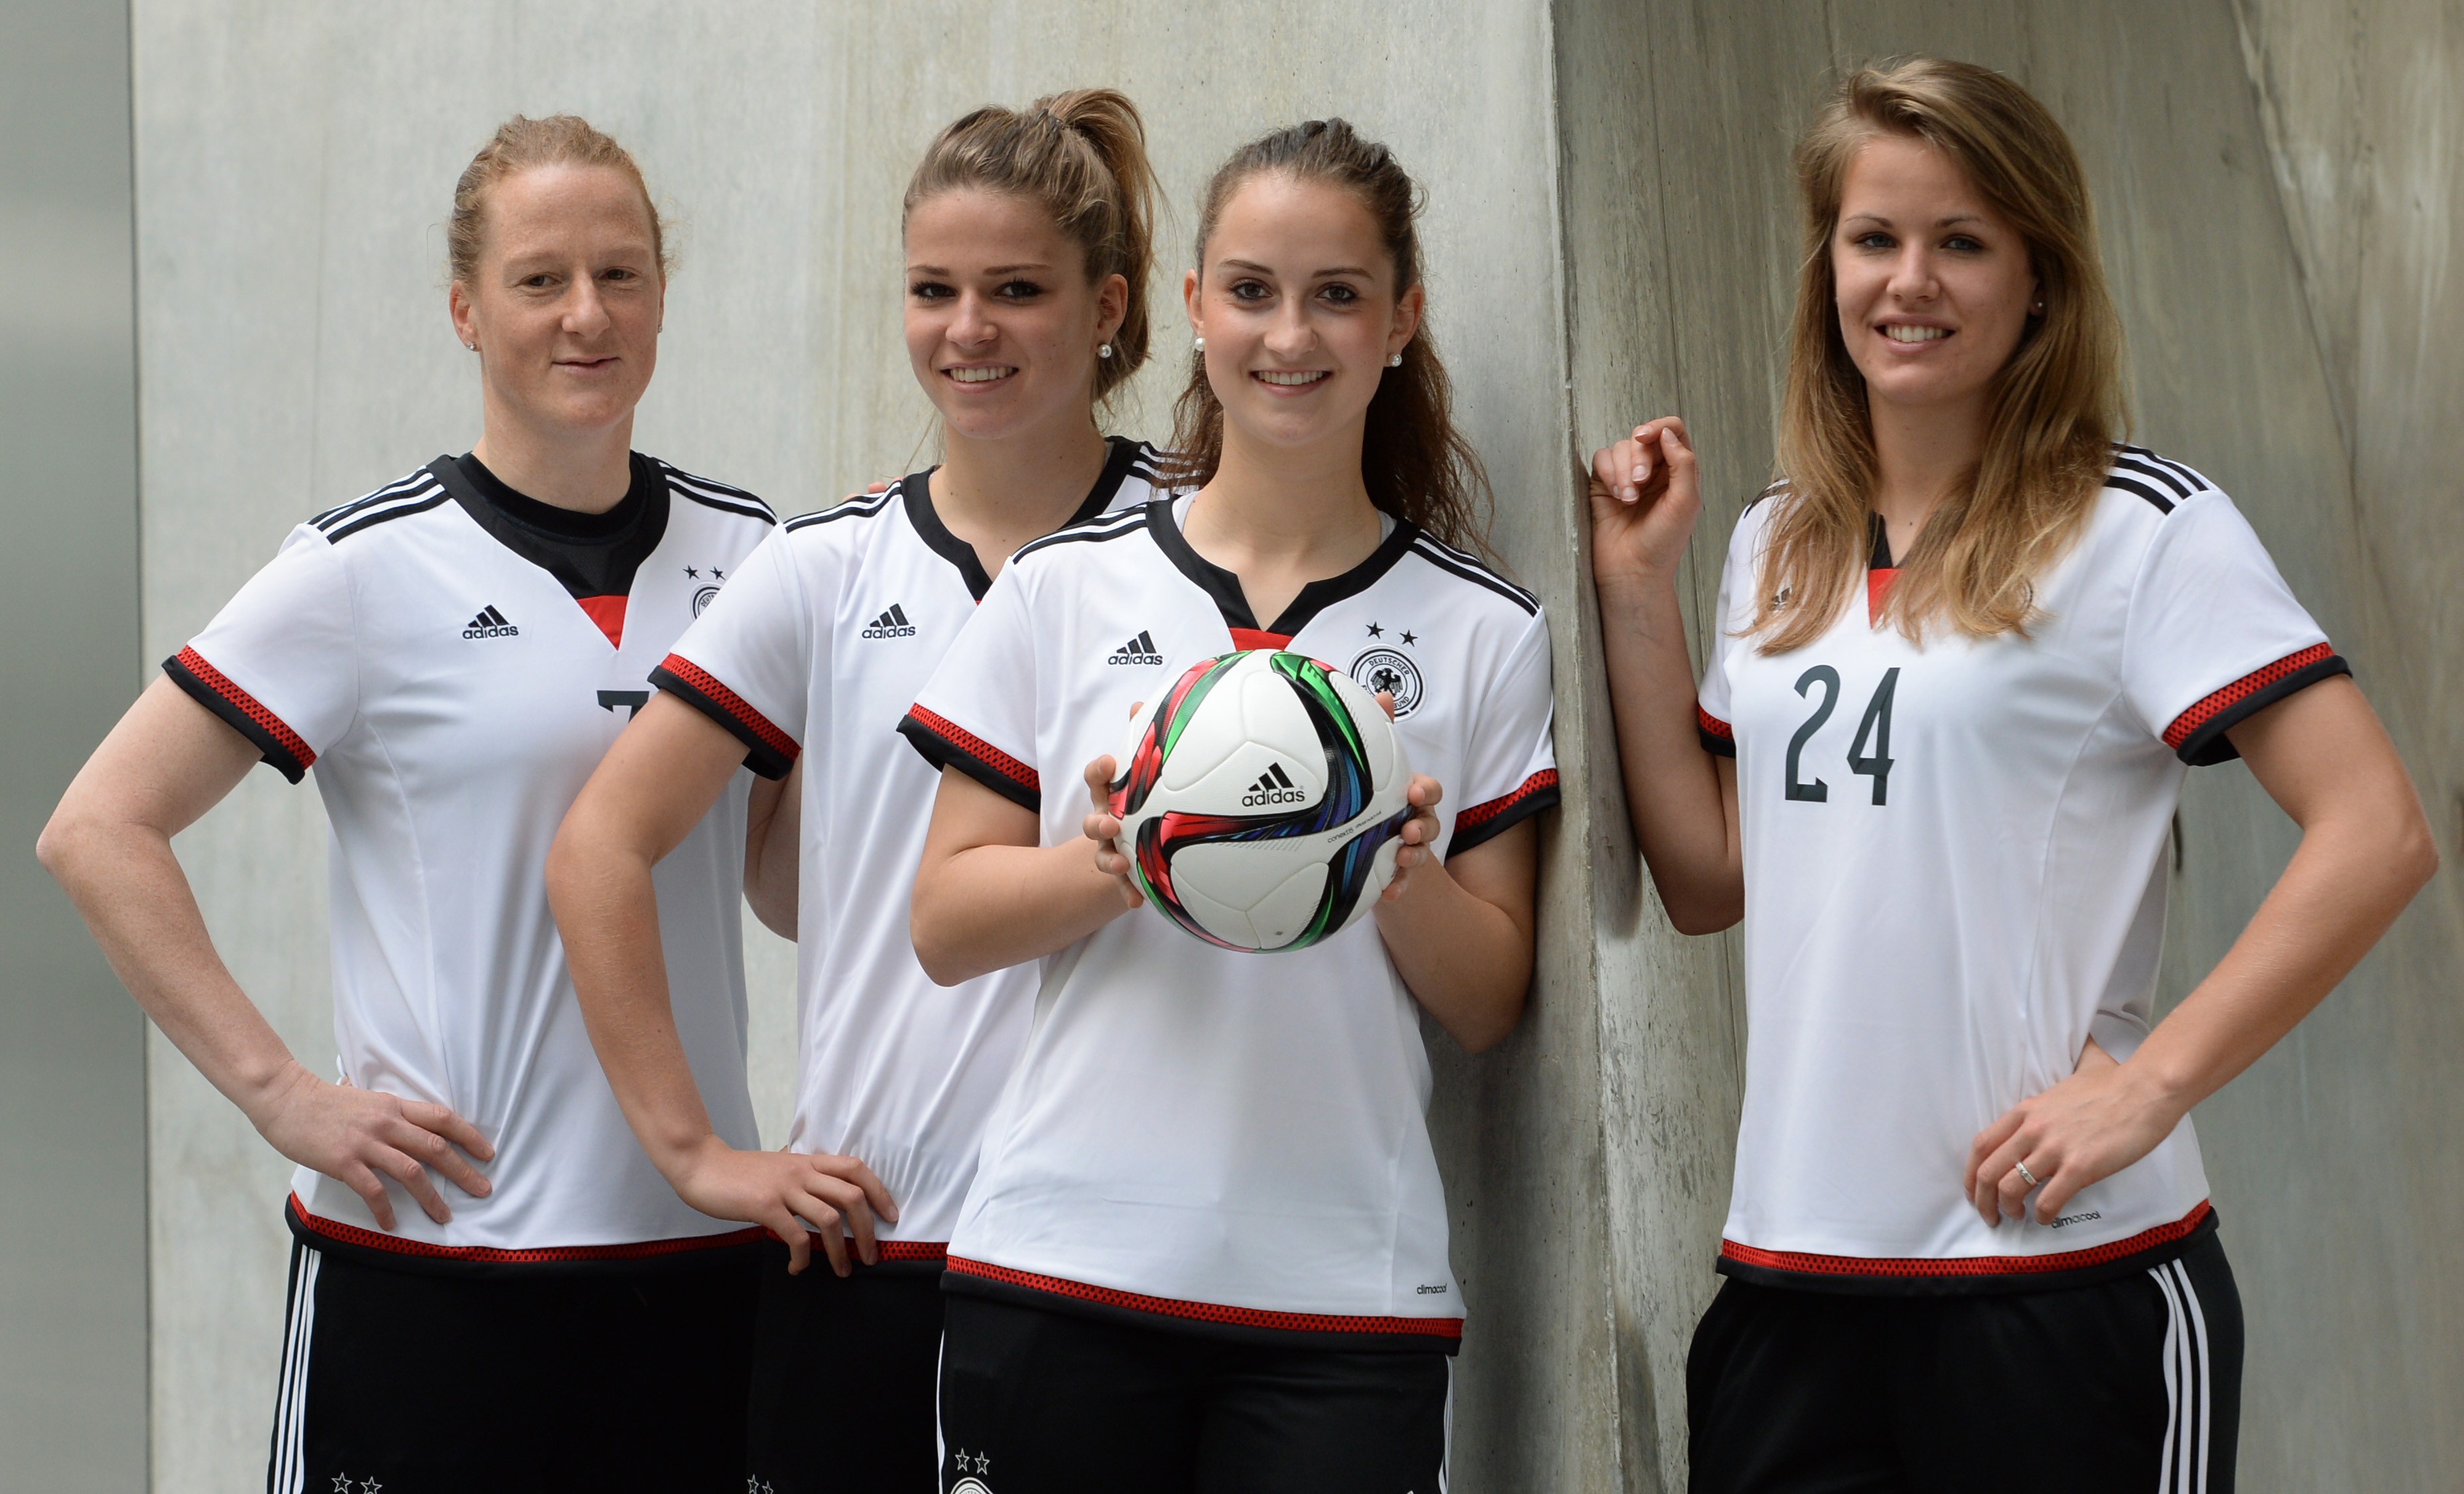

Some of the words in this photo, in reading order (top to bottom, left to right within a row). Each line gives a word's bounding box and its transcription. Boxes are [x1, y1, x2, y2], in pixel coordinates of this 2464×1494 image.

[462, 626, 519, 639] adidas
[862, 625, 916, 639] adidas
[1108, 652, 1163, 665] adidas
[1368, 657, 1410, 675] DEUTSCHER
[1785, 664, 1901, 806] 24
[1242, 789, 1305, 807] adidas
